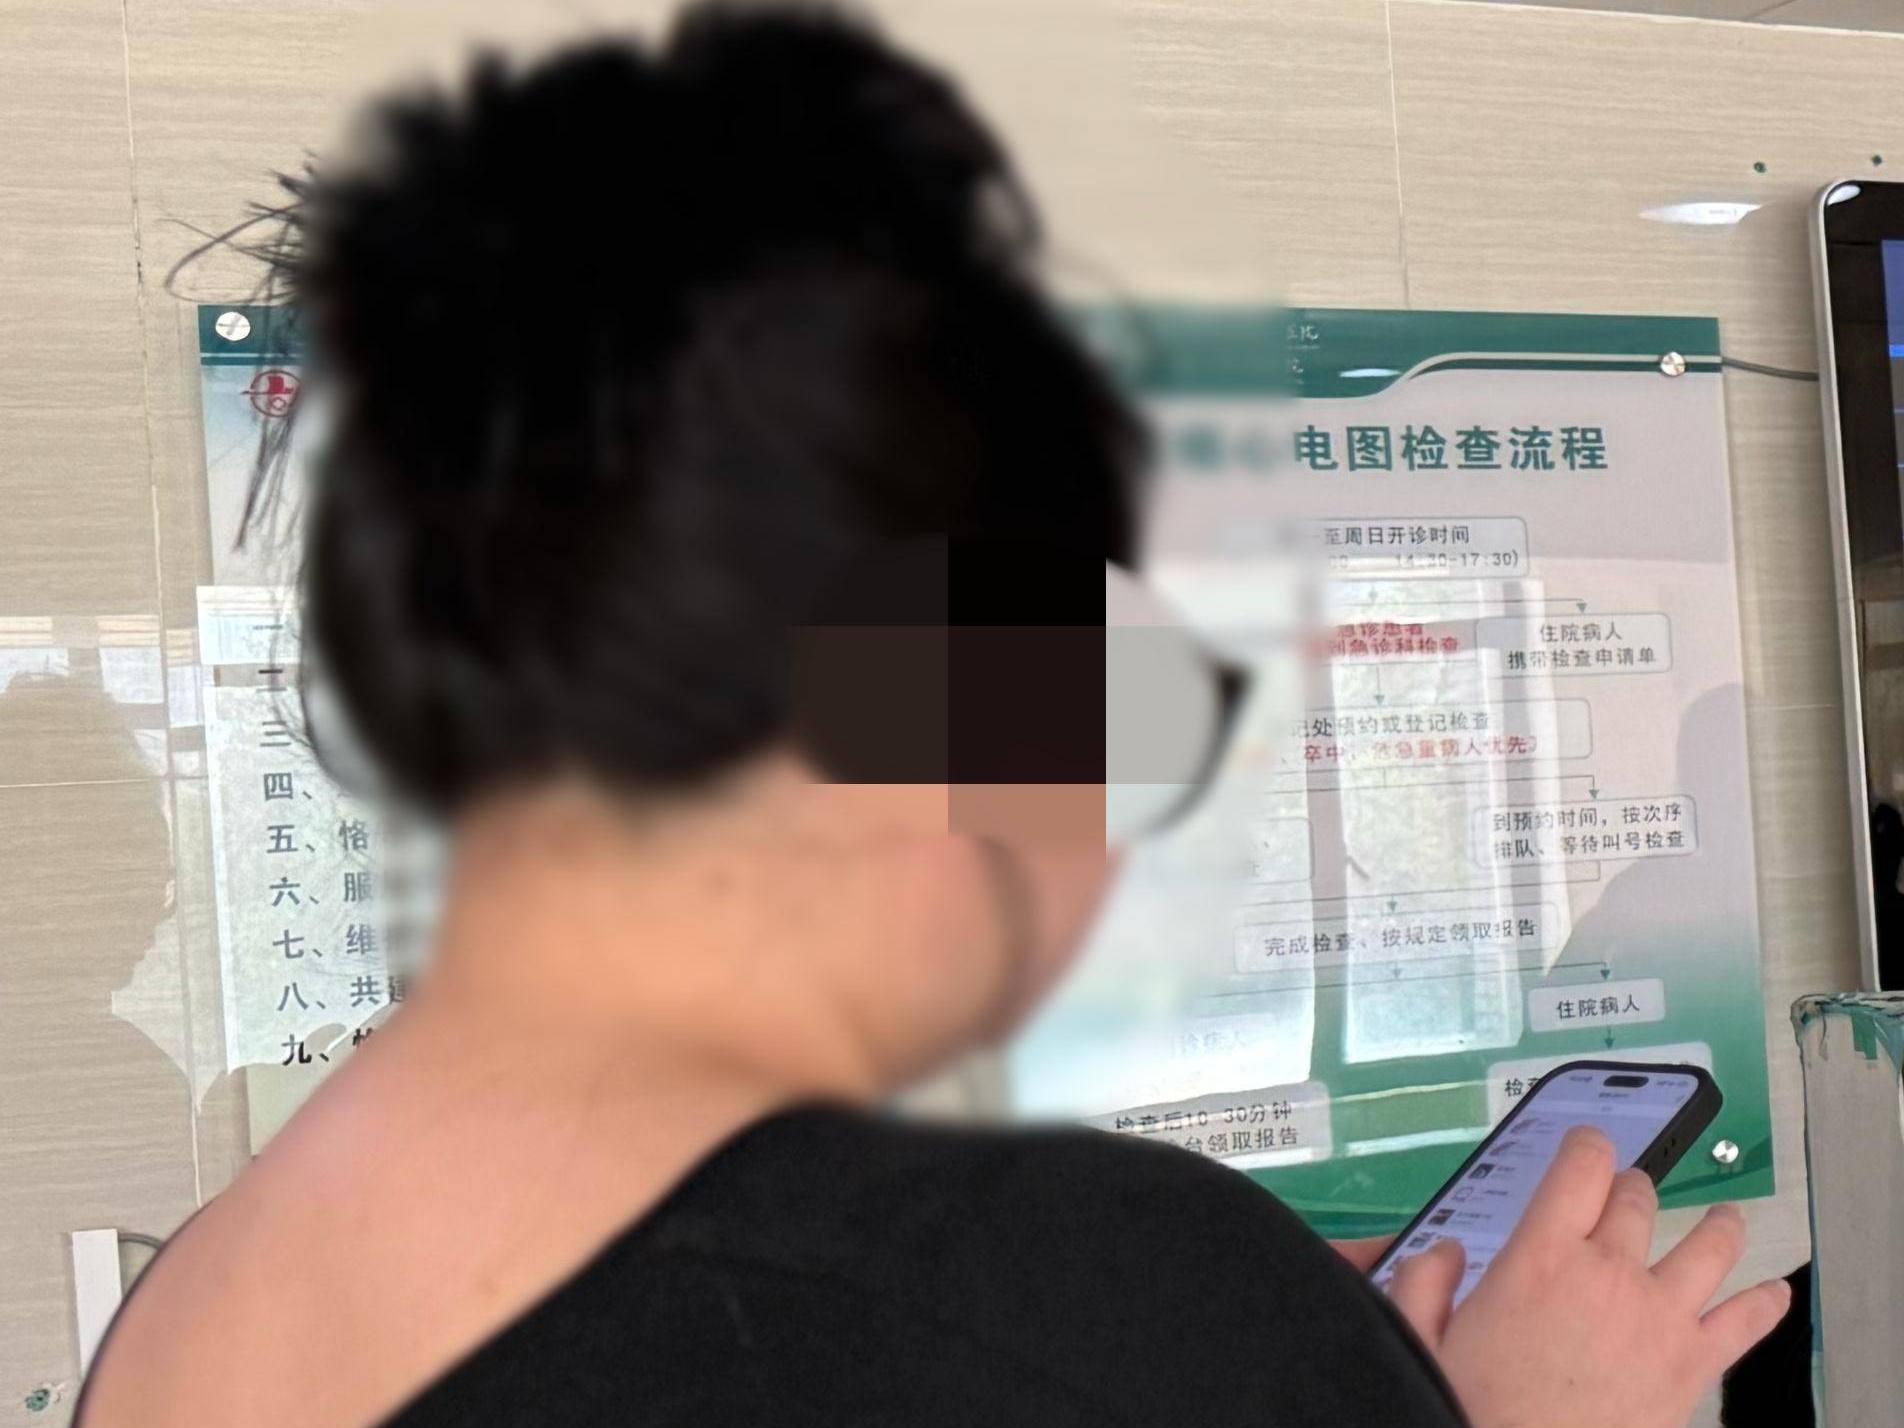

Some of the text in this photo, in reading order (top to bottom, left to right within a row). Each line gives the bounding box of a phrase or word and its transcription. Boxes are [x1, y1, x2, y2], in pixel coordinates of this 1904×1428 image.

[1540, 622, 1623, 643] 住院病人
[1556, 994, 1640, 1019] 住院病人
